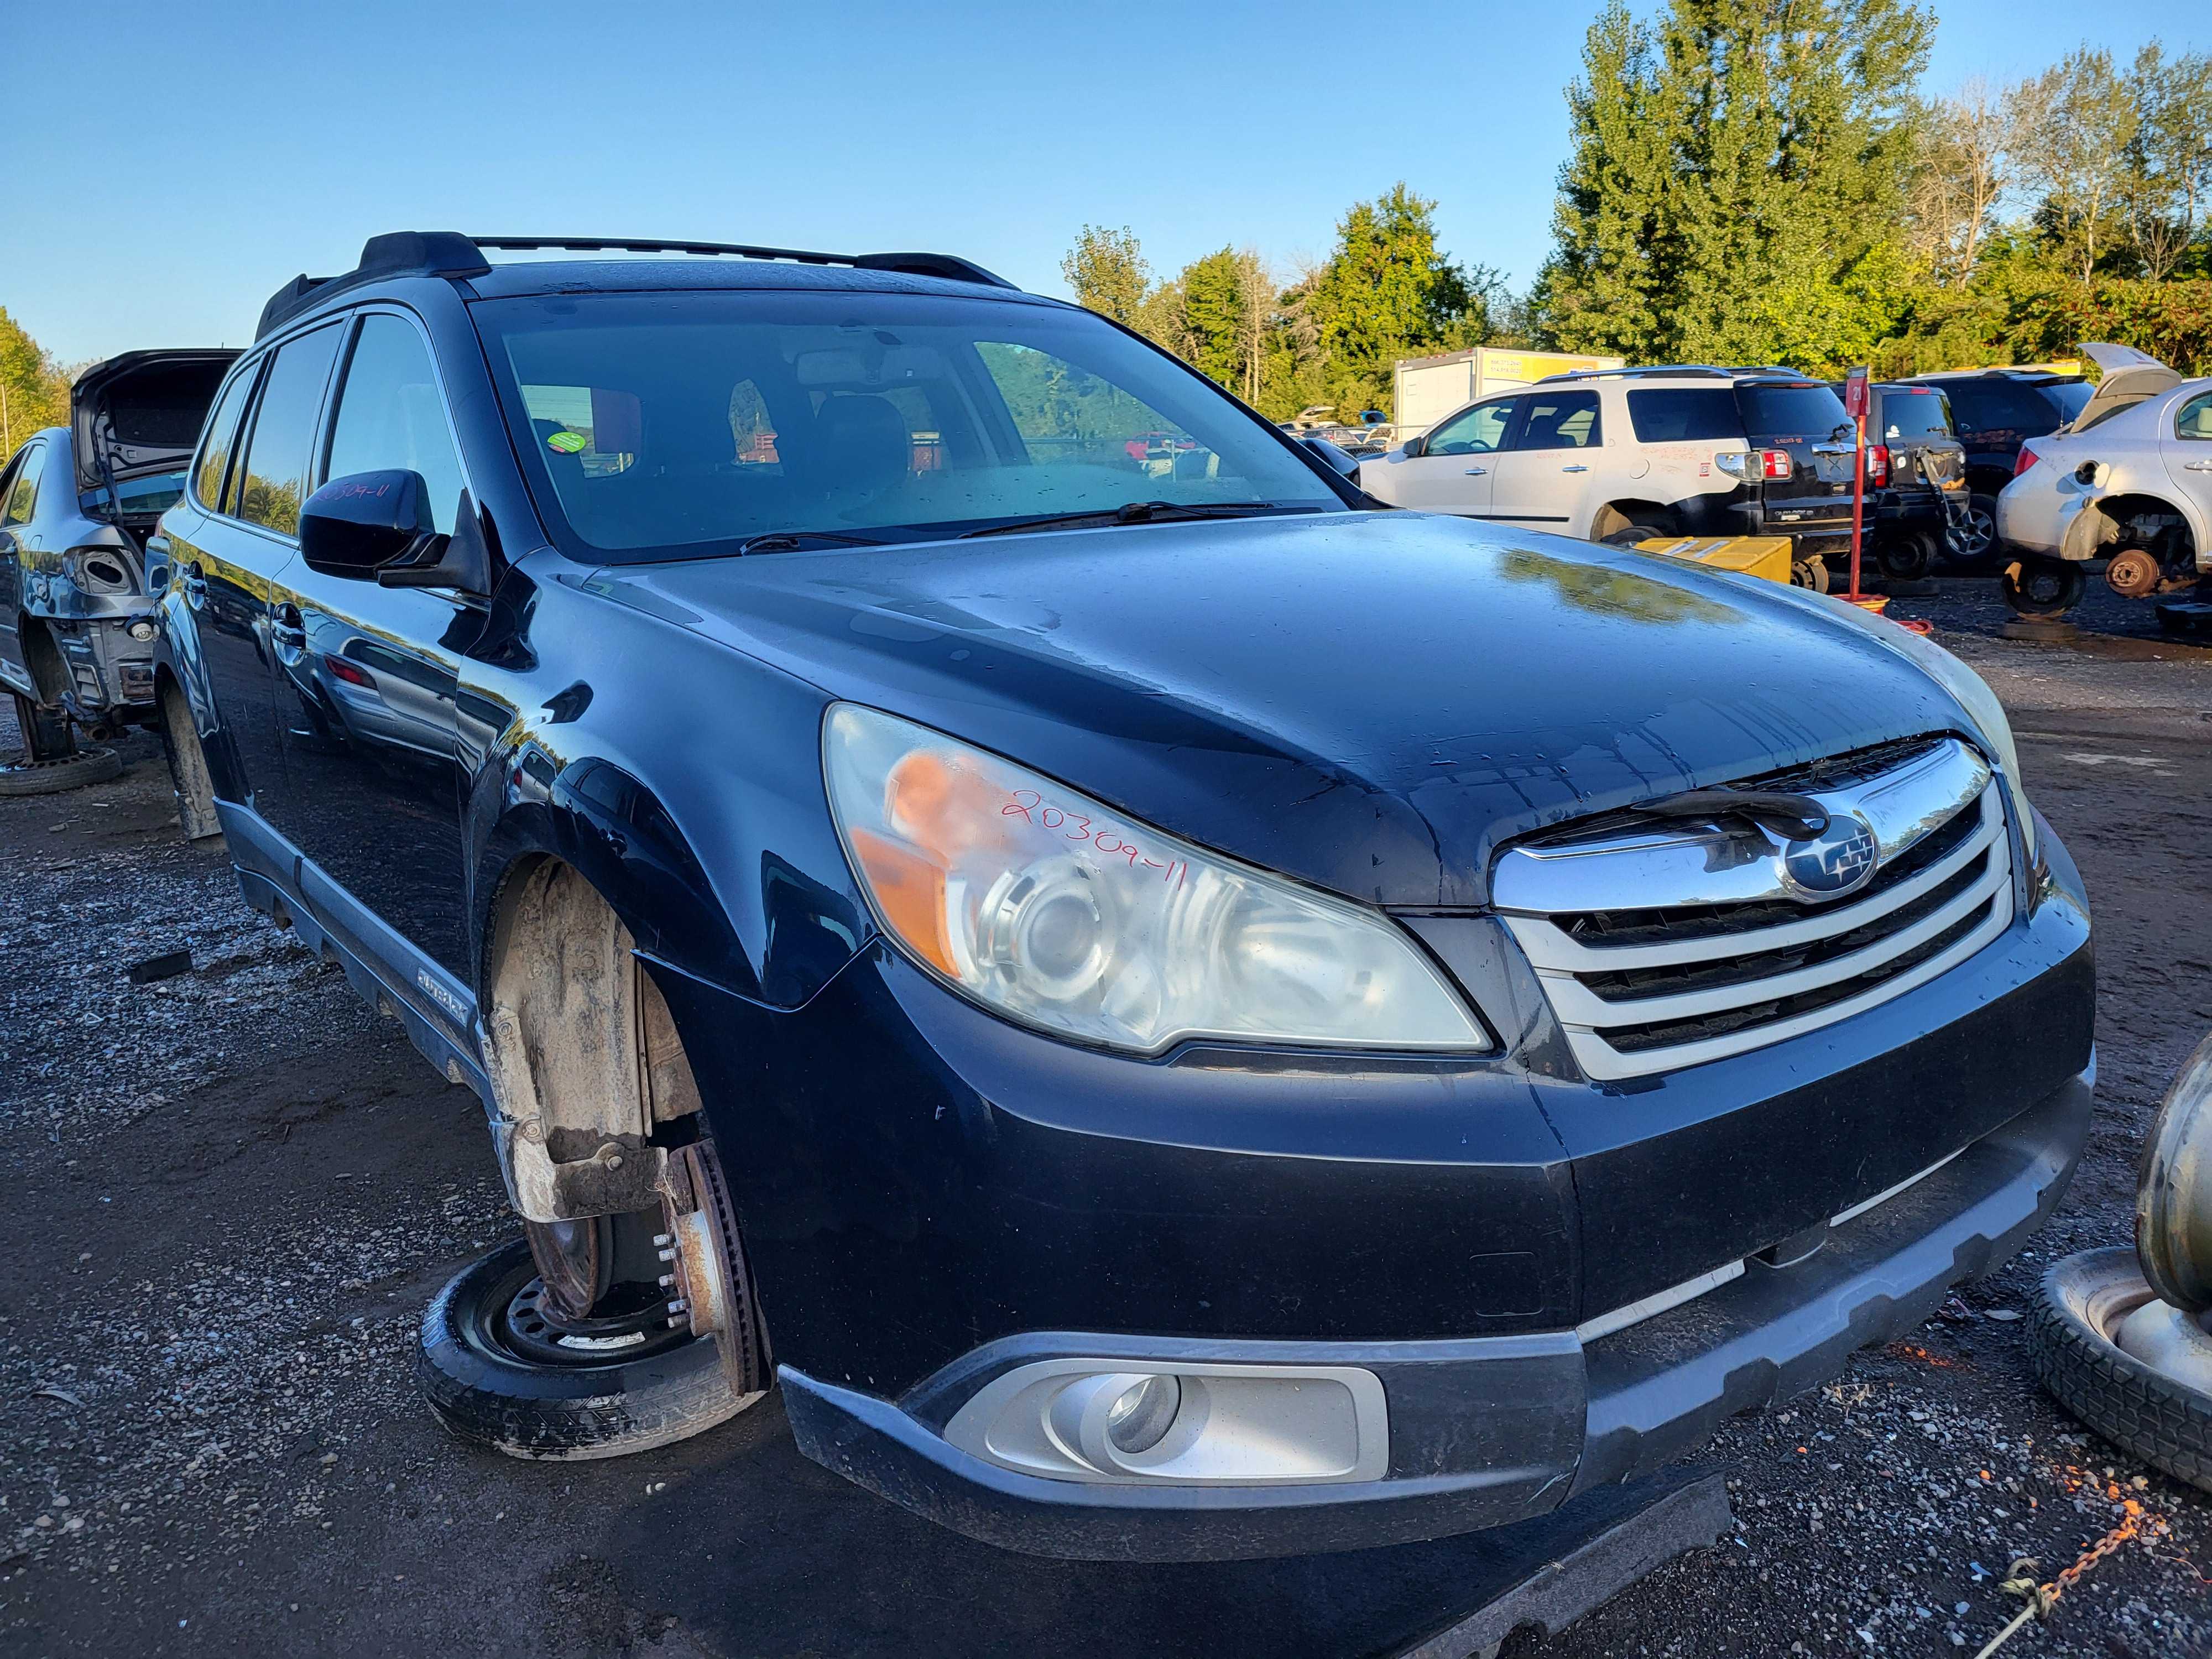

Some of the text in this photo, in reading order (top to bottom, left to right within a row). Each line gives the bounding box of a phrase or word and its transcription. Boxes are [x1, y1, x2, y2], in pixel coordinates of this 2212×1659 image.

[1853, 385, 1862, 401] 21
[1001, 790, 1187, 891] 20309-11
[418, 971, 469, 1024] OUTBACK
